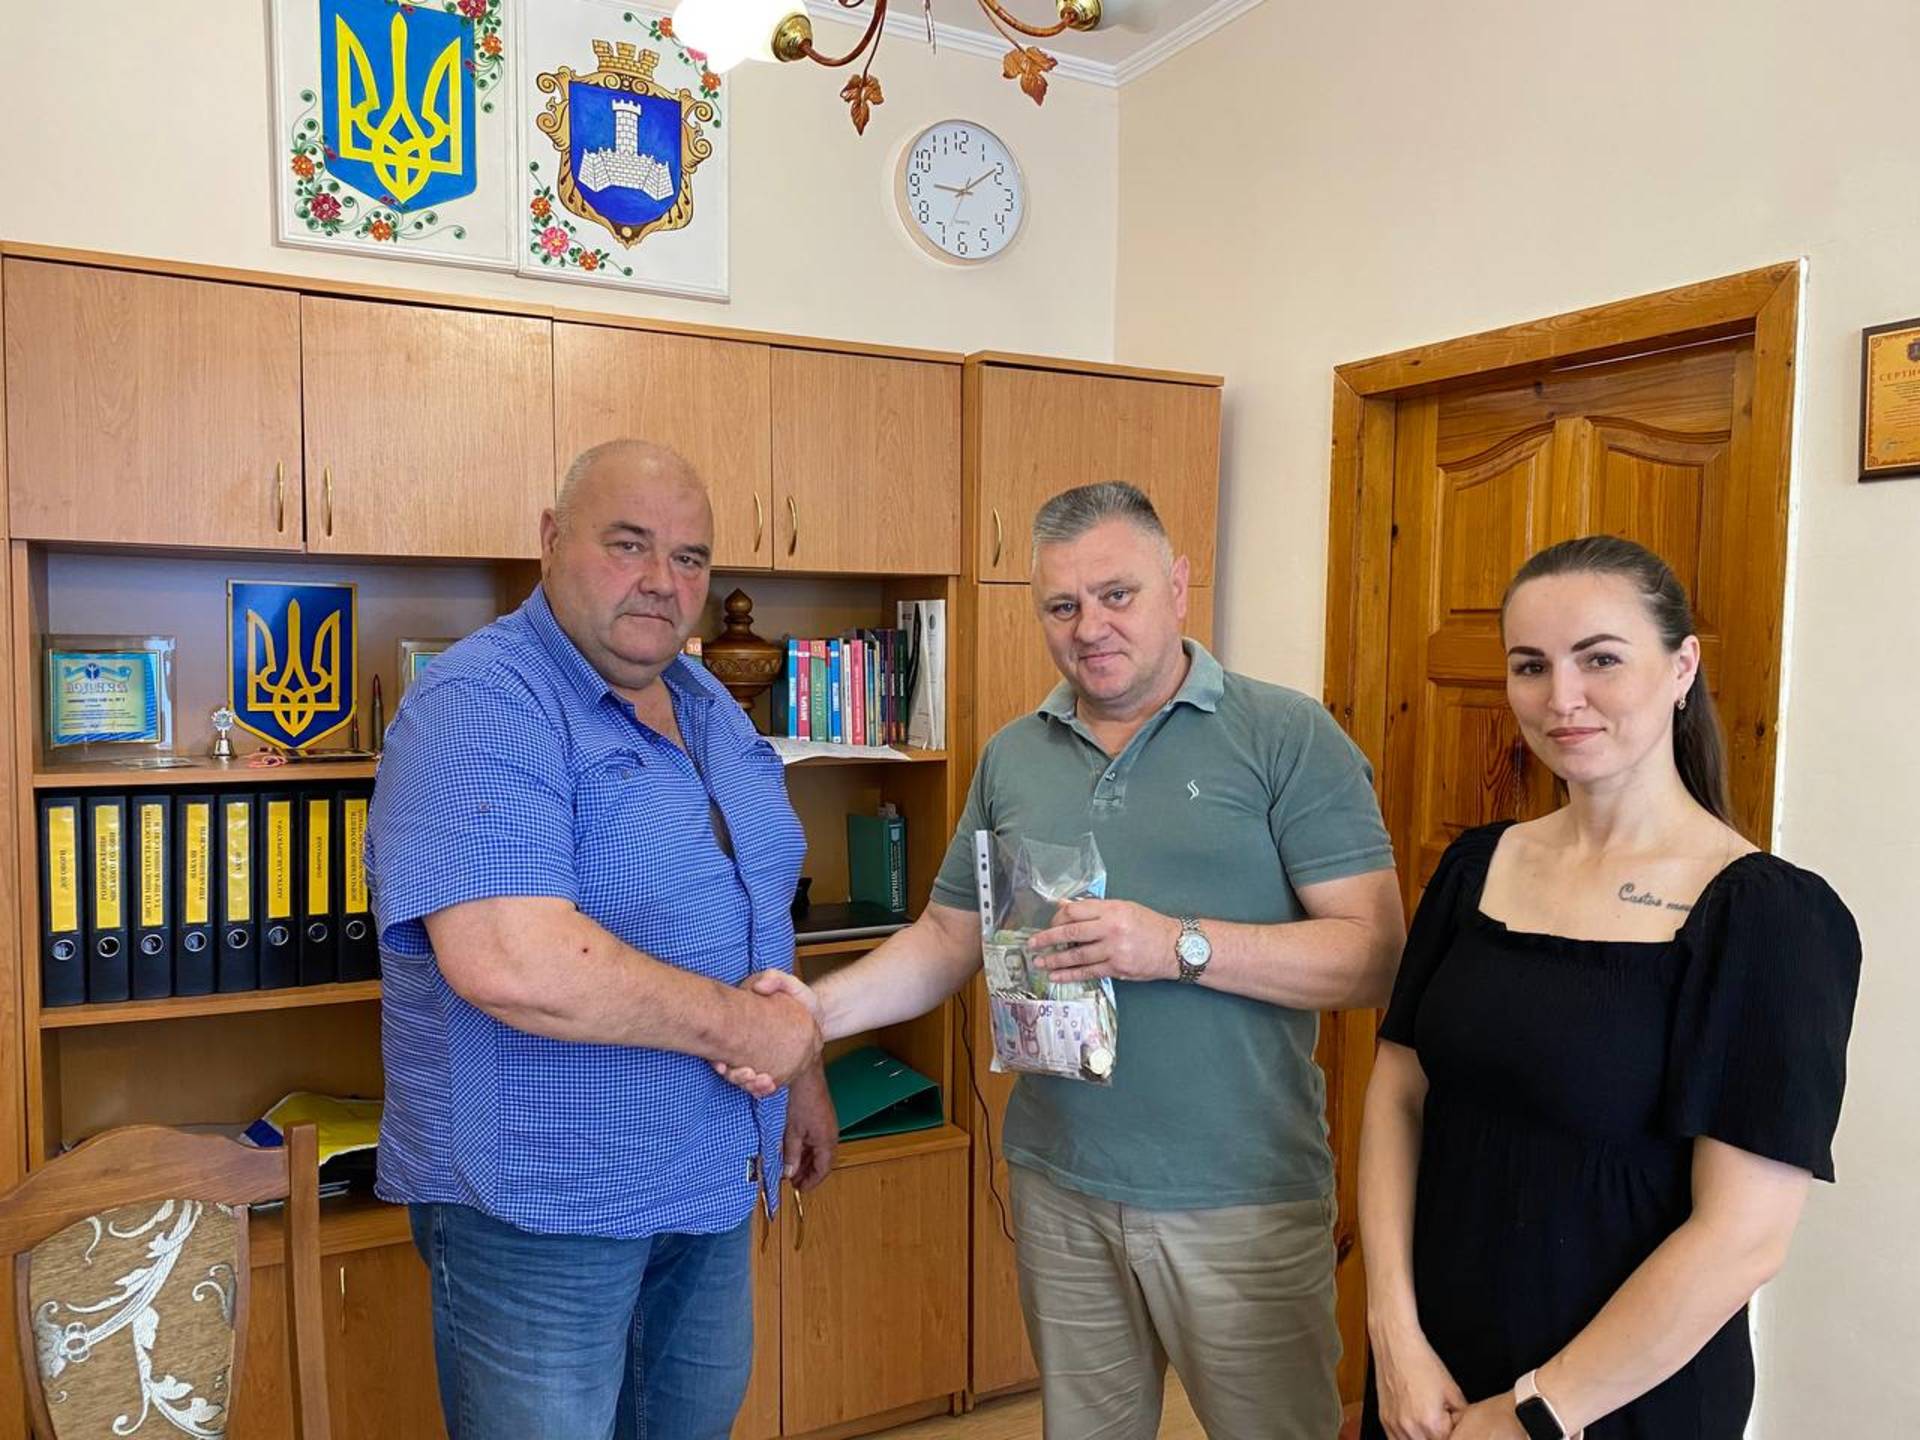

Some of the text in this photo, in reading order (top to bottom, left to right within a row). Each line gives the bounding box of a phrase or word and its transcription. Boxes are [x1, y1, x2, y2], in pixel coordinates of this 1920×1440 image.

[932, 134, 948, 155] 11
[954, 131, 969, 154] 12
[916, 149, 931, 173] 10
[909, 173, 920, 197] 9
[994, 162, 1004, 186] 2
[919, 200, 929, 224] 8
[1004, 188, 1014, 212] 3
[936, 221, 945, 245] 7
[995, 213, 1005, 235] 4
[958, 231, 968, 255] 6
[979, 228, 989, 251] 5
